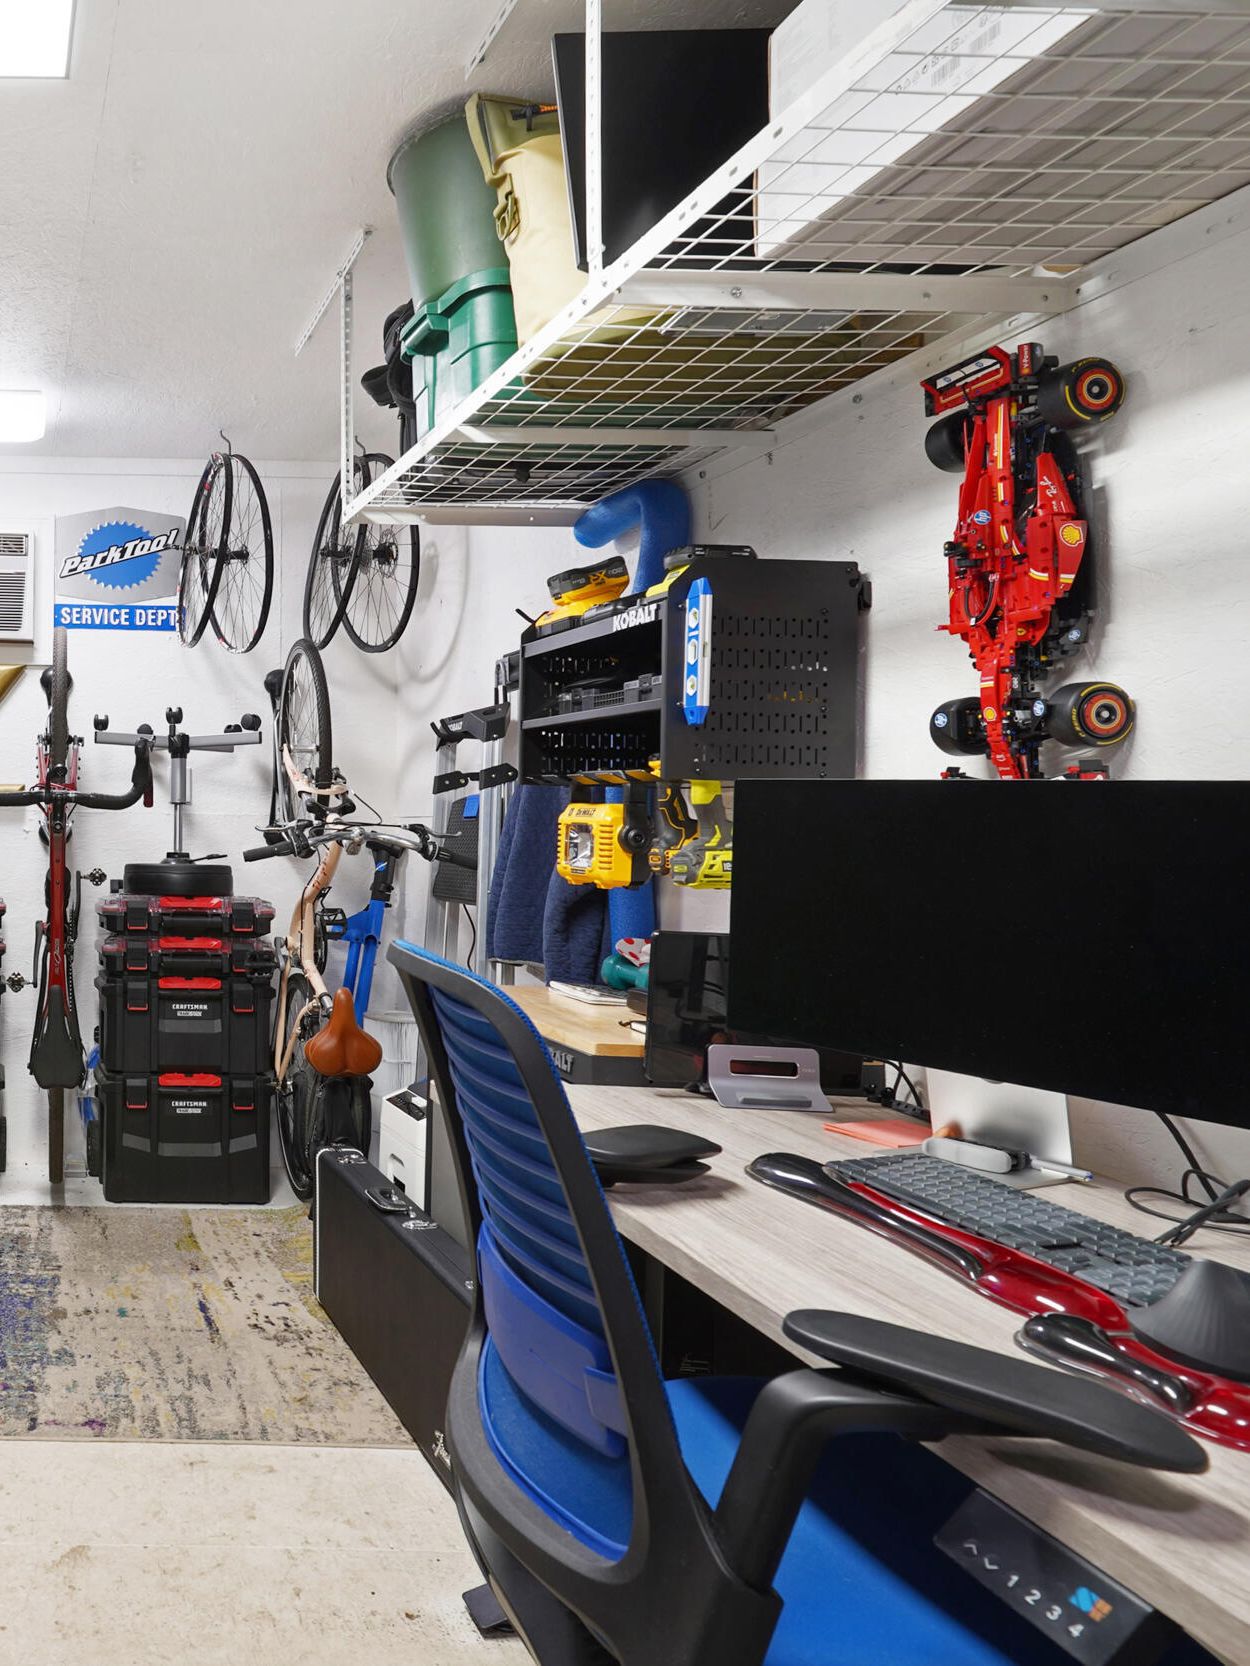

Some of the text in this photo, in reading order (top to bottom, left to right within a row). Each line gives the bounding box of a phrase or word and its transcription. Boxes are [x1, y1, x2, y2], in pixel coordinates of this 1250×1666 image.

[974, 510, 991, 525] hp
[60, 607, 130, 625] SERVICE
[613, 603, 658, 632] KOBALT
[1006, 1574, 1085, 1639] 1 2 3 4
